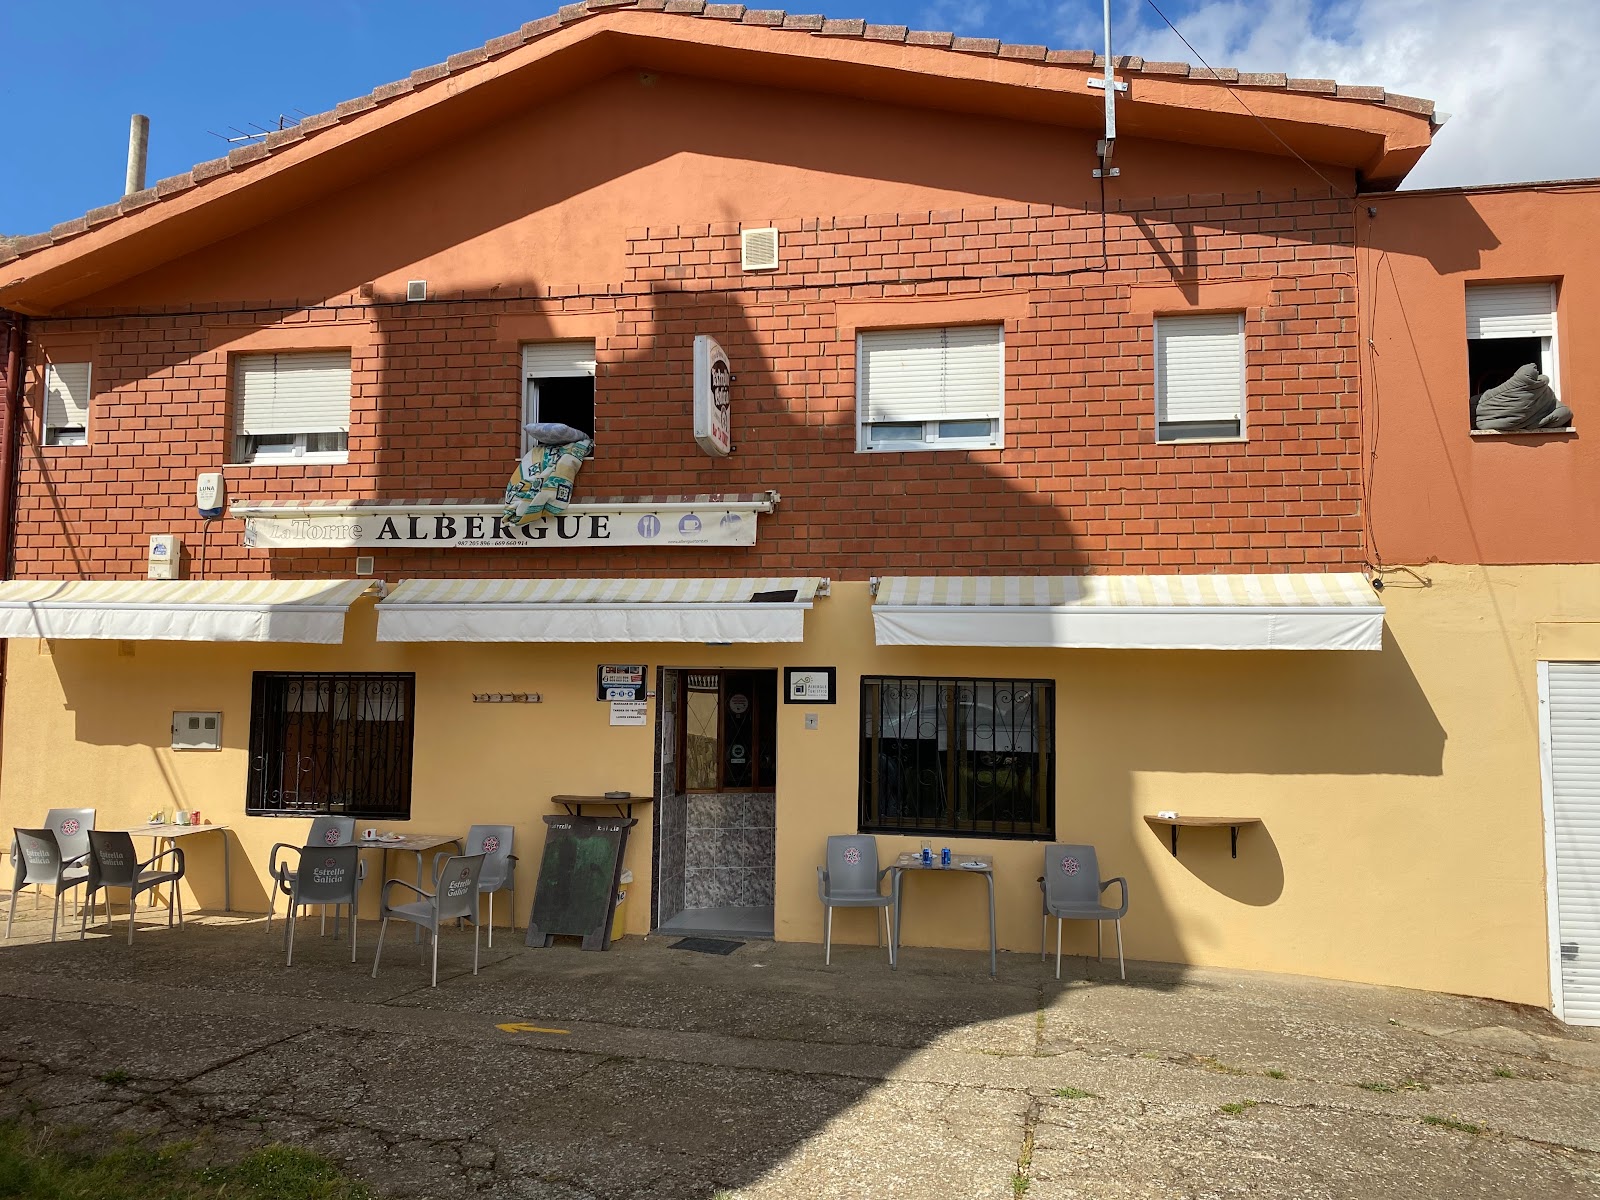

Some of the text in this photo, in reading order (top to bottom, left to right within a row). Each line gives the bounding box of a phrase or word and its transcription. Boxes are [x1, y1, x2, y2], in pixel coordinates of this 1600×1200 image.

[291, 519, 363, 540] Torre
[375, 516, 611, 540] ALBERGUE
[26, 849, 50, 859] Estrella
[100, 849, 124, 859] Estrella
[313, 867, 345, 876] Estrella
[313, 875, 343, 884] Galicia
[449, 878, 472, 889] Estrella
